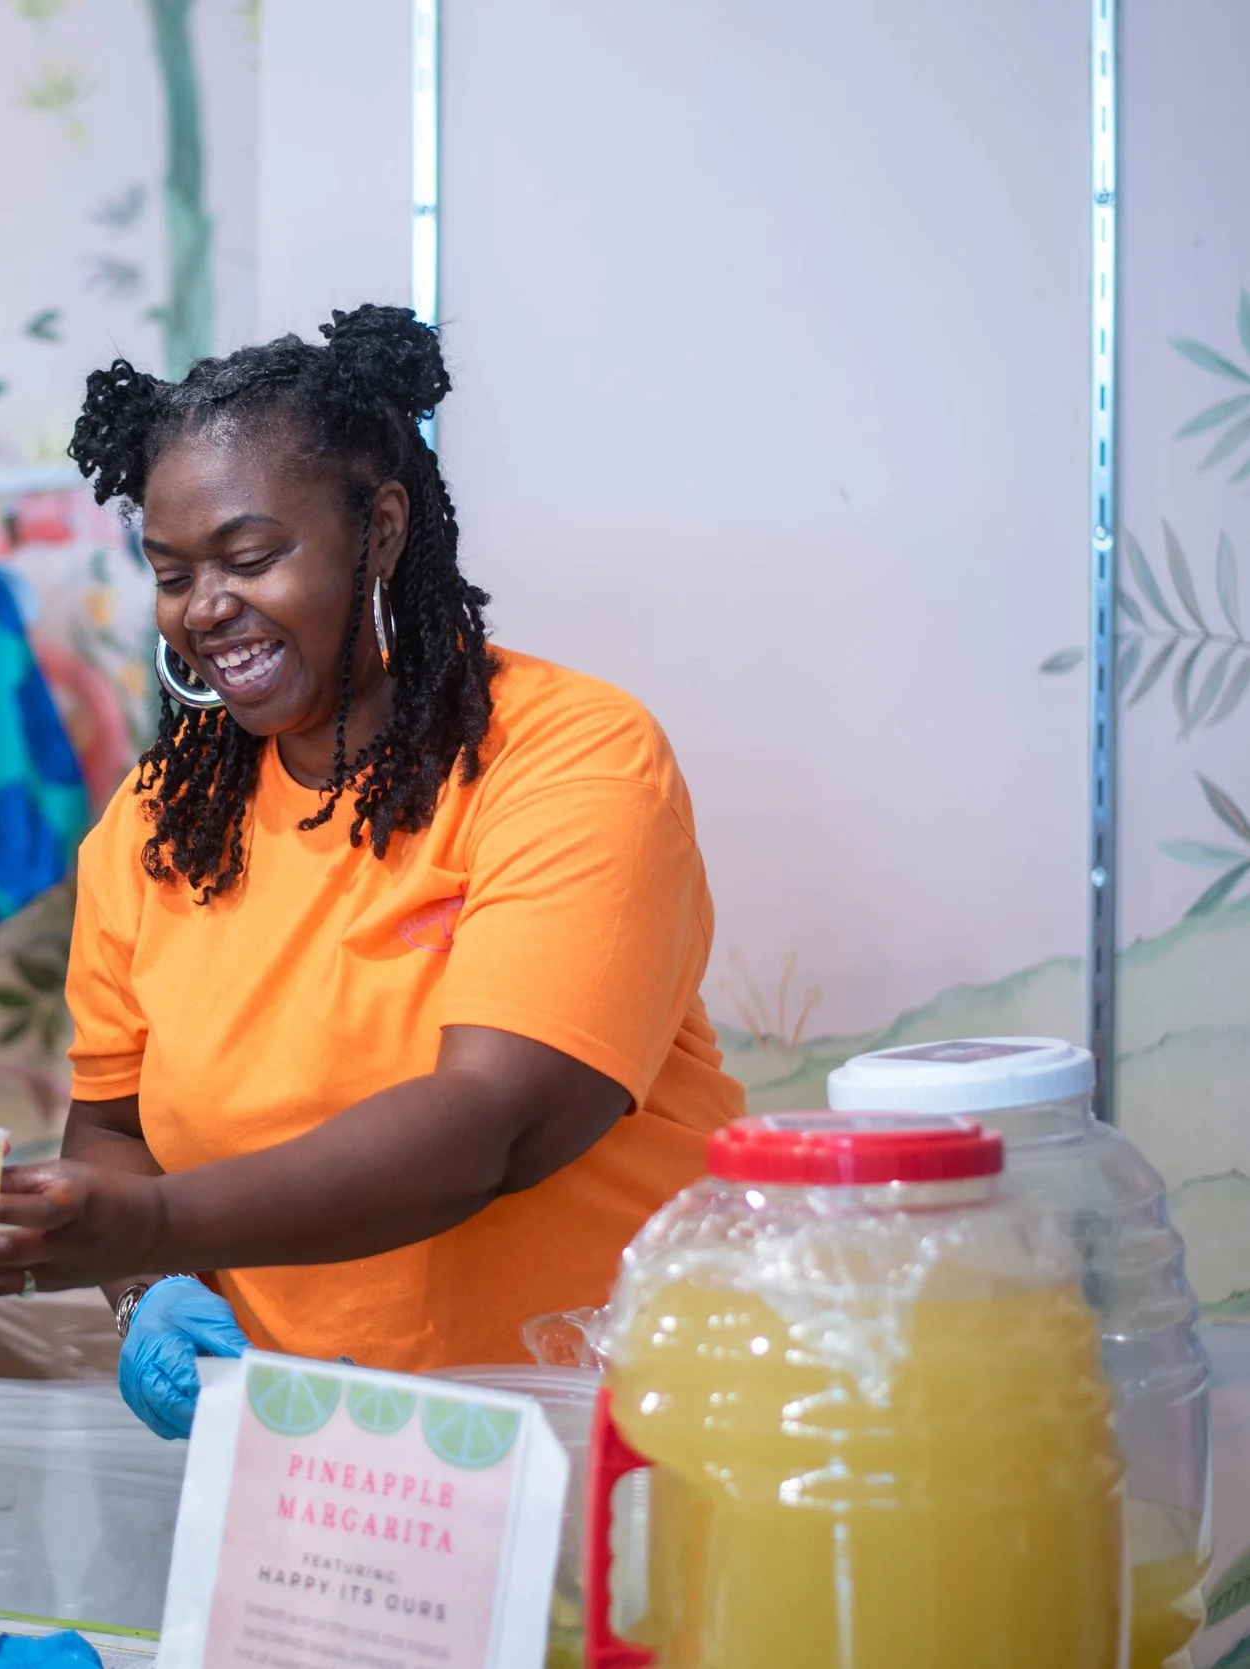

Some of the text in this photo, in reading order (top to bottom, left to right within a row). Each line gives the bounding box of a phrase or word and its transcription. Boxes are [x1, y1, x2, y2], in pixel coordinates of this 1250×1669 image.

[287, 1453, 456, 1510] PINEAPPLE
[276, 1492, 454, 1554] MARGARITA
[257, 1565, 331, 1596] HAPPY
[338, 1582, 375, 1607] ITS
[383, 1591, 447, 1622] OURS
